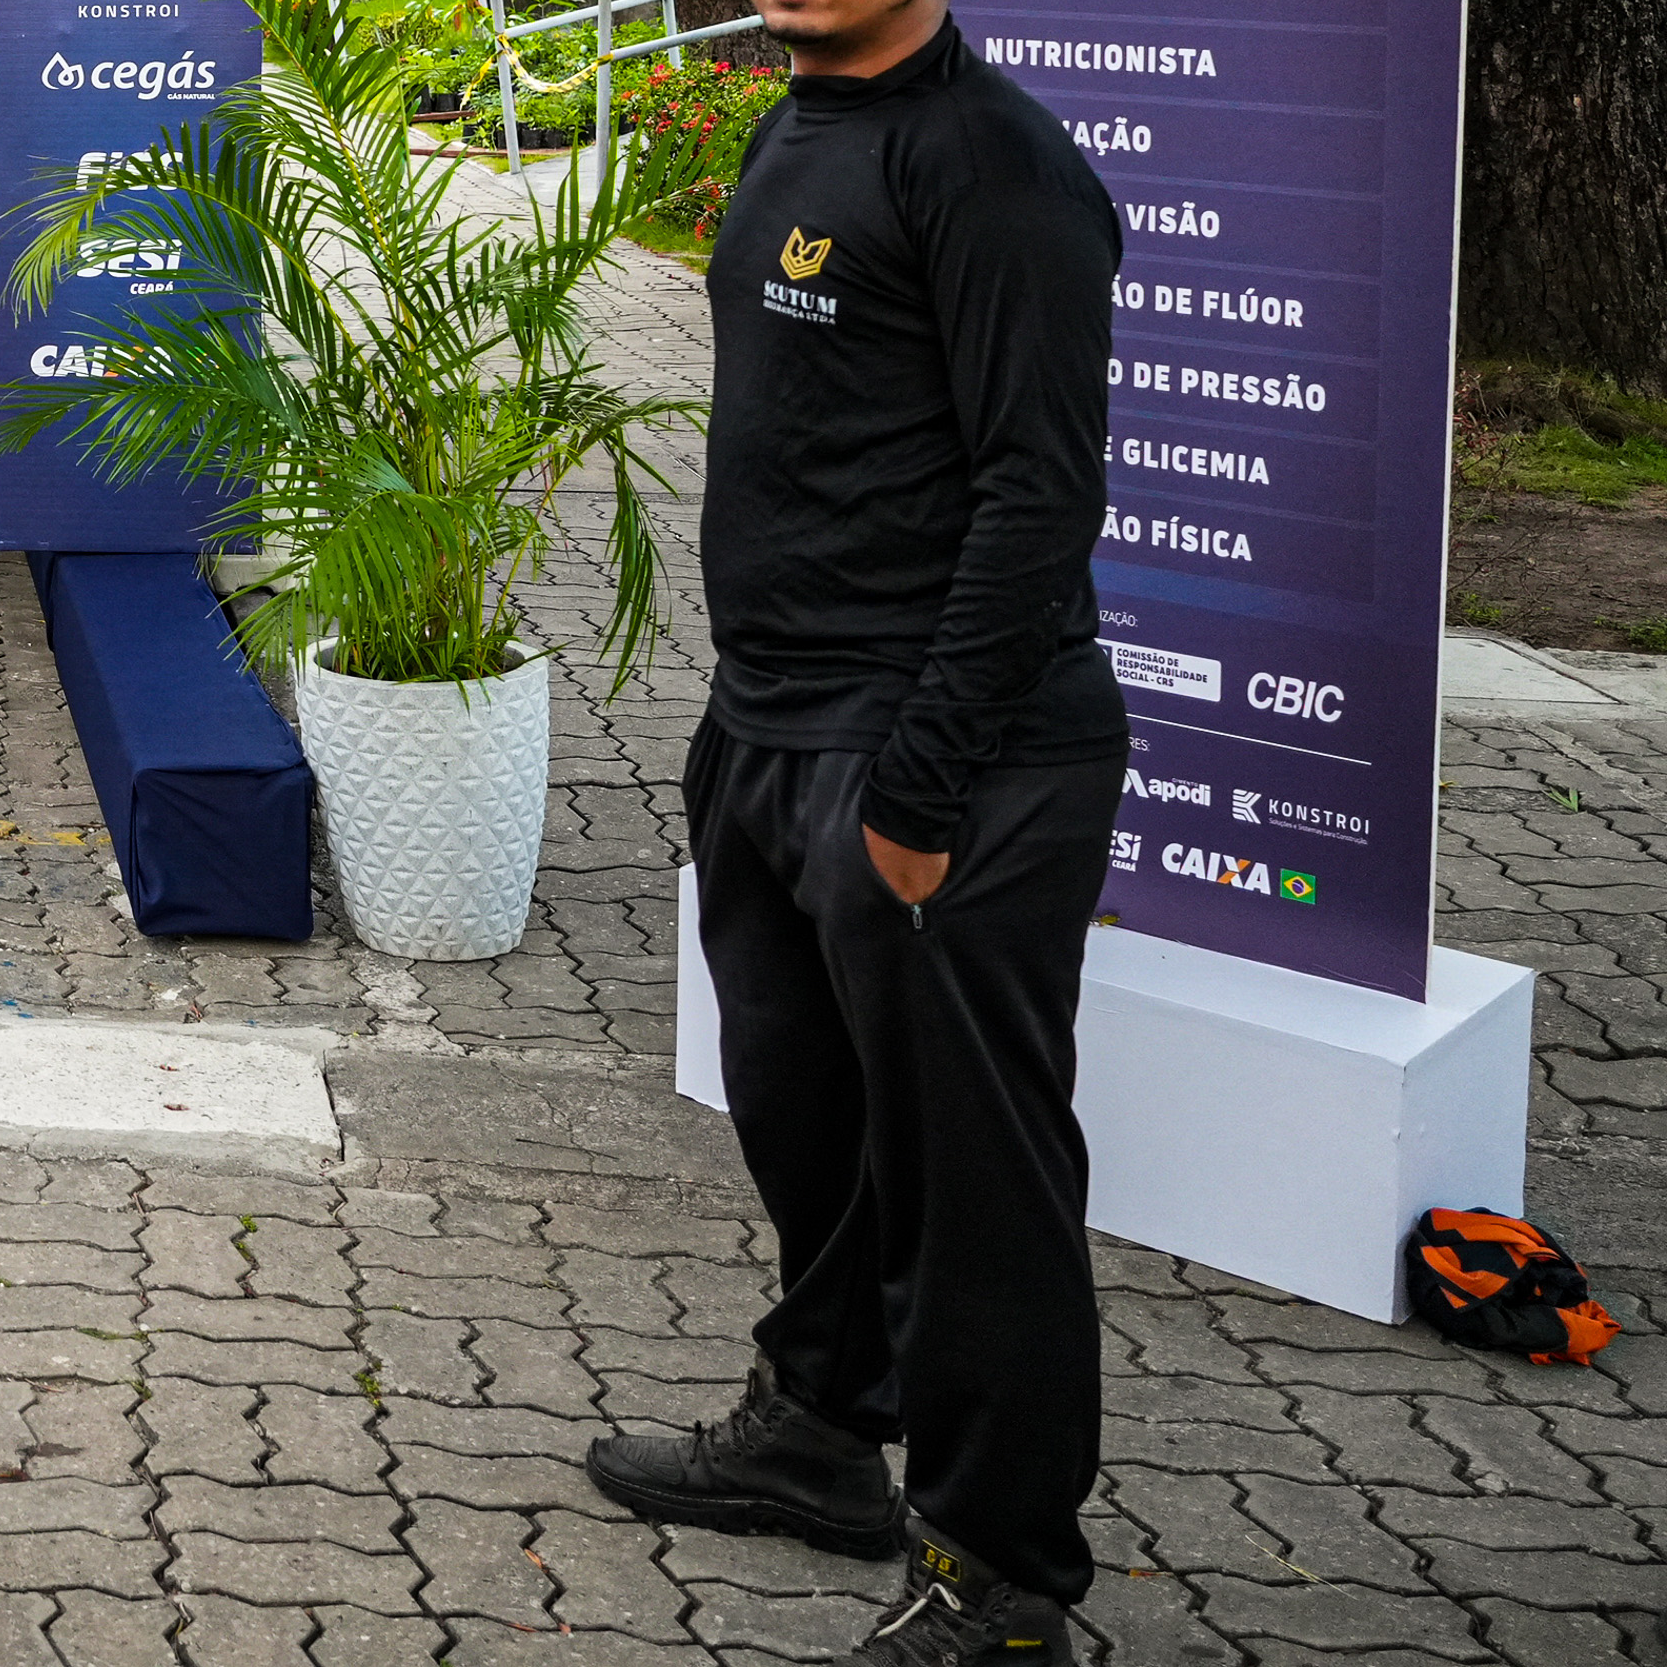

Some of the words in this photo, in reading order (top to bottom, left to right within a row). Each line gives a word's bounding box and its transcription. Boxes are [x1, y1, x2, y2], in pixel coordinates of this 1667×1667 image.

[78, 4, 179, 18] KONSTROI
[91, 50, 216, 100] cegás
[985, 37, 1217, 77] NUTRICIONISTA
[1126, 201, 1220, 238] VISÃO
[763, 280, 837, 315] SCUTUM
[1155, 284, 1192, 315] DE
[1203, 288, 1303, 328] FLÚOR
[1133, 362, 1171, 392] DE
[1180, 368, 1326, 412] PRESSÃO
[1122, 438, 1270, 485] GLICEMIA
[1151, 516, 1252, 561] FÍSICA
[1117, 648, 1165, 665] COMISSÃO
[1167, 657, 1179, 667] DE
[1117, 659, 1208, 683] RESPONSABILIDADE
[1116, 668, 1149, 682] SOCIAL
[1156, 677, 1174, 687] CRS
[1246, 672, 1345, 723] CBIC
[1148, 783, 1211, 807] apodi
[1268, 798, 1369, 835] KONSTROI
[1111, 859, 1136, 872] CEARÁ
[1161, 842, 1271, 895] CAIXA
